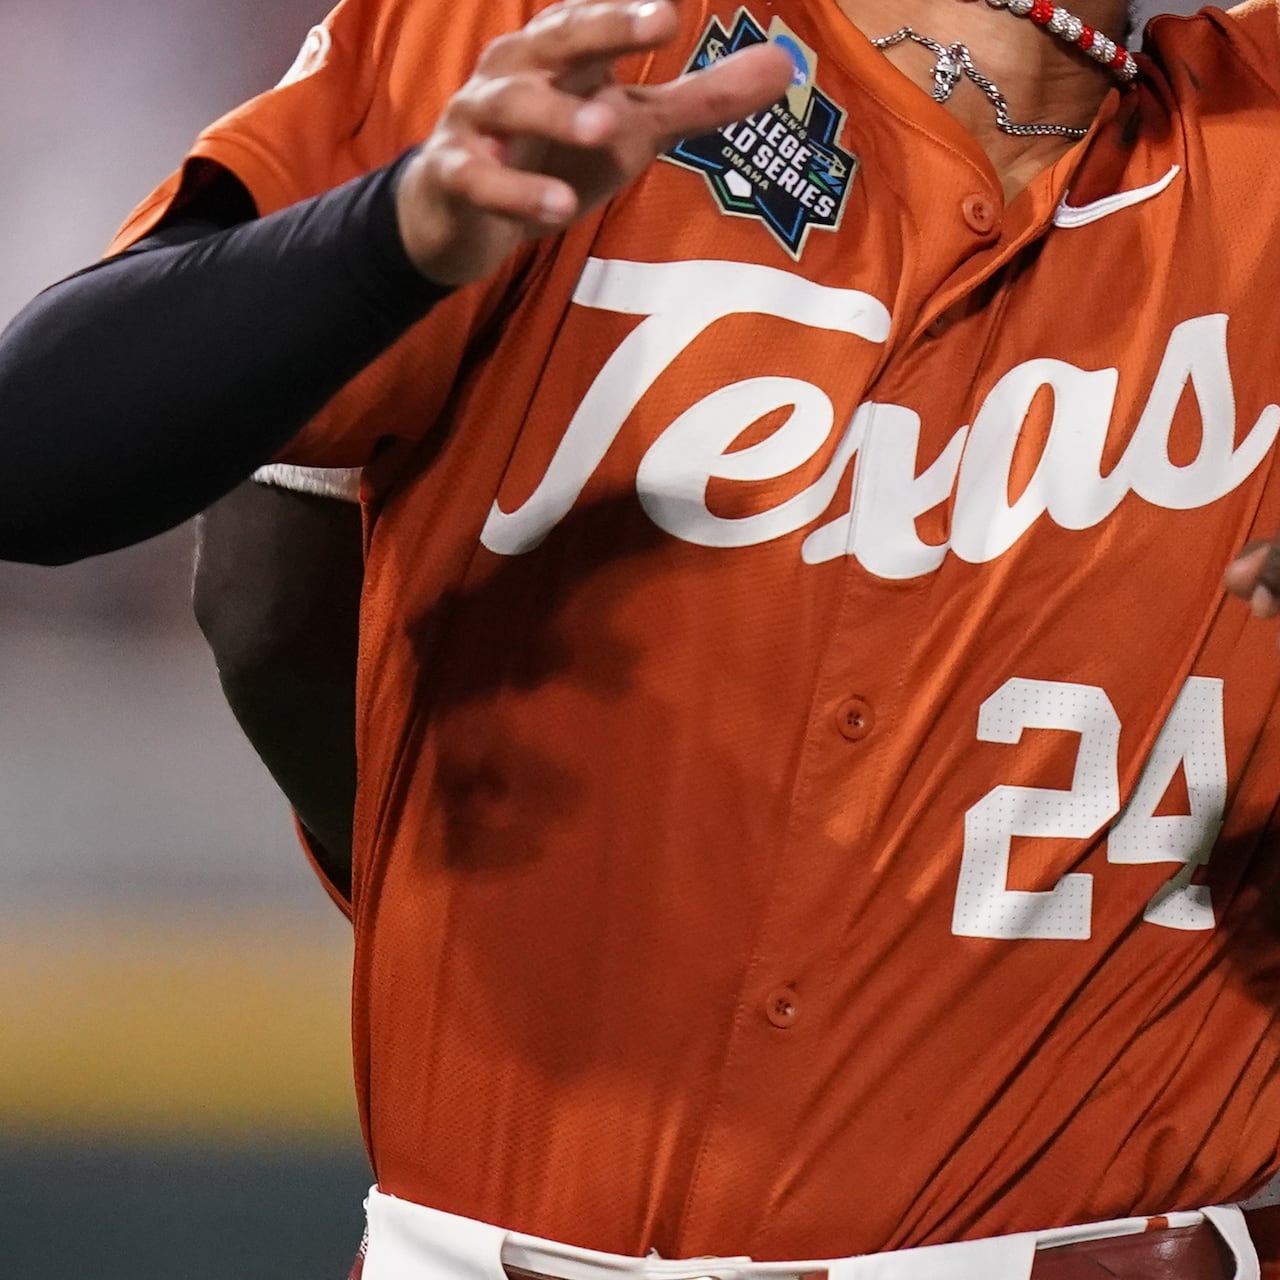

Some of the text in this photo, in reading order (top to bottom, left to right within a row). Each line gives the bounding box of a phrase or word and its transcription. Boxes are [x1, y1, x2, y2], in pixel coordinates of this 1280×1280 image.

[771, 103, 808, 141] MEN'S
[721, 146, 770, 191] OMAHA
[751, 144, 836, 218] SERIES
[951, 675, 1228, 941] 24
